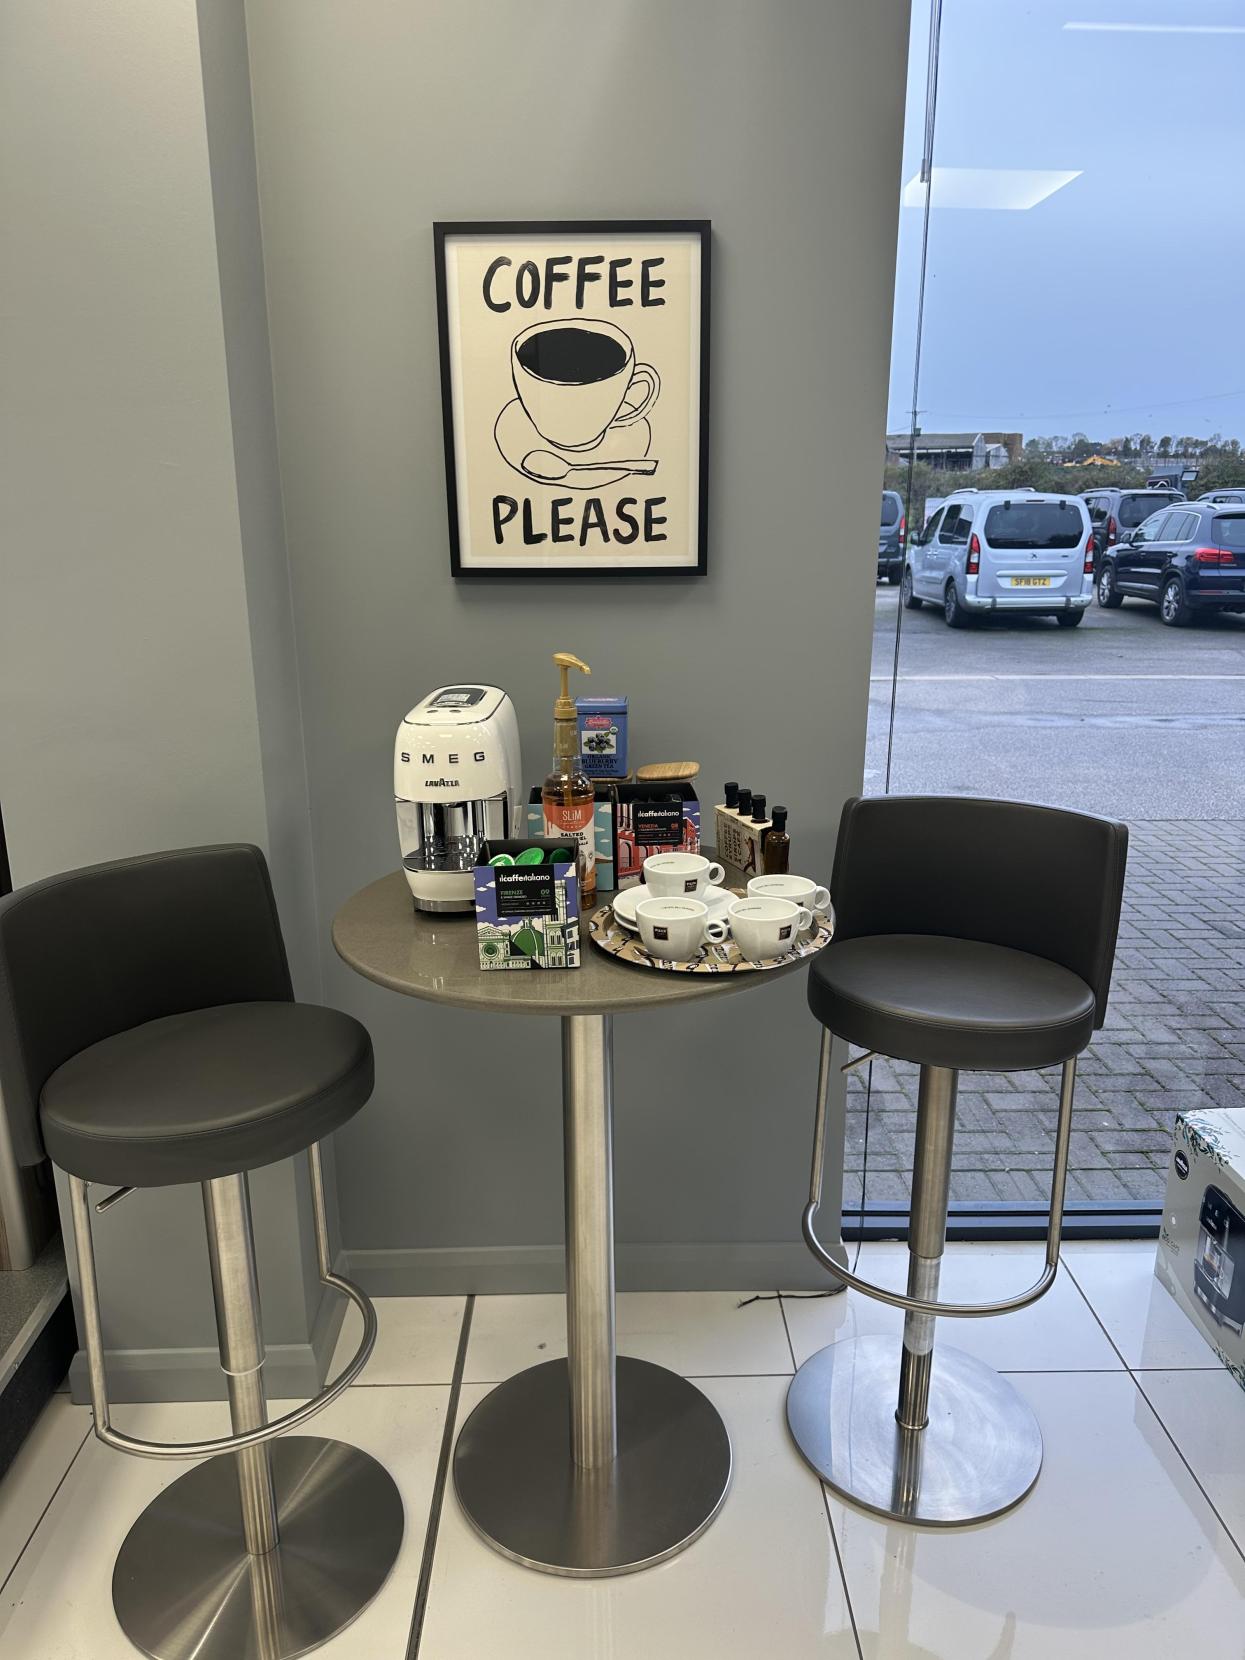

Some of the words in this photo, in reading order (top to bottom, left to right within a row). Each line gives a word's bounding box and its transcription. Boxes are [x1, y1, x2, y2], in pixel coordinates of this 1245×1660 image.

[482, 255, 666, 313] COFFEE
[492, 494, 668, 546] PLEASE
[400, 751, 486, 764] SMEG
[425, 778, 460, 787] LAVAZZA
[540, 888, 550, 896] 09
